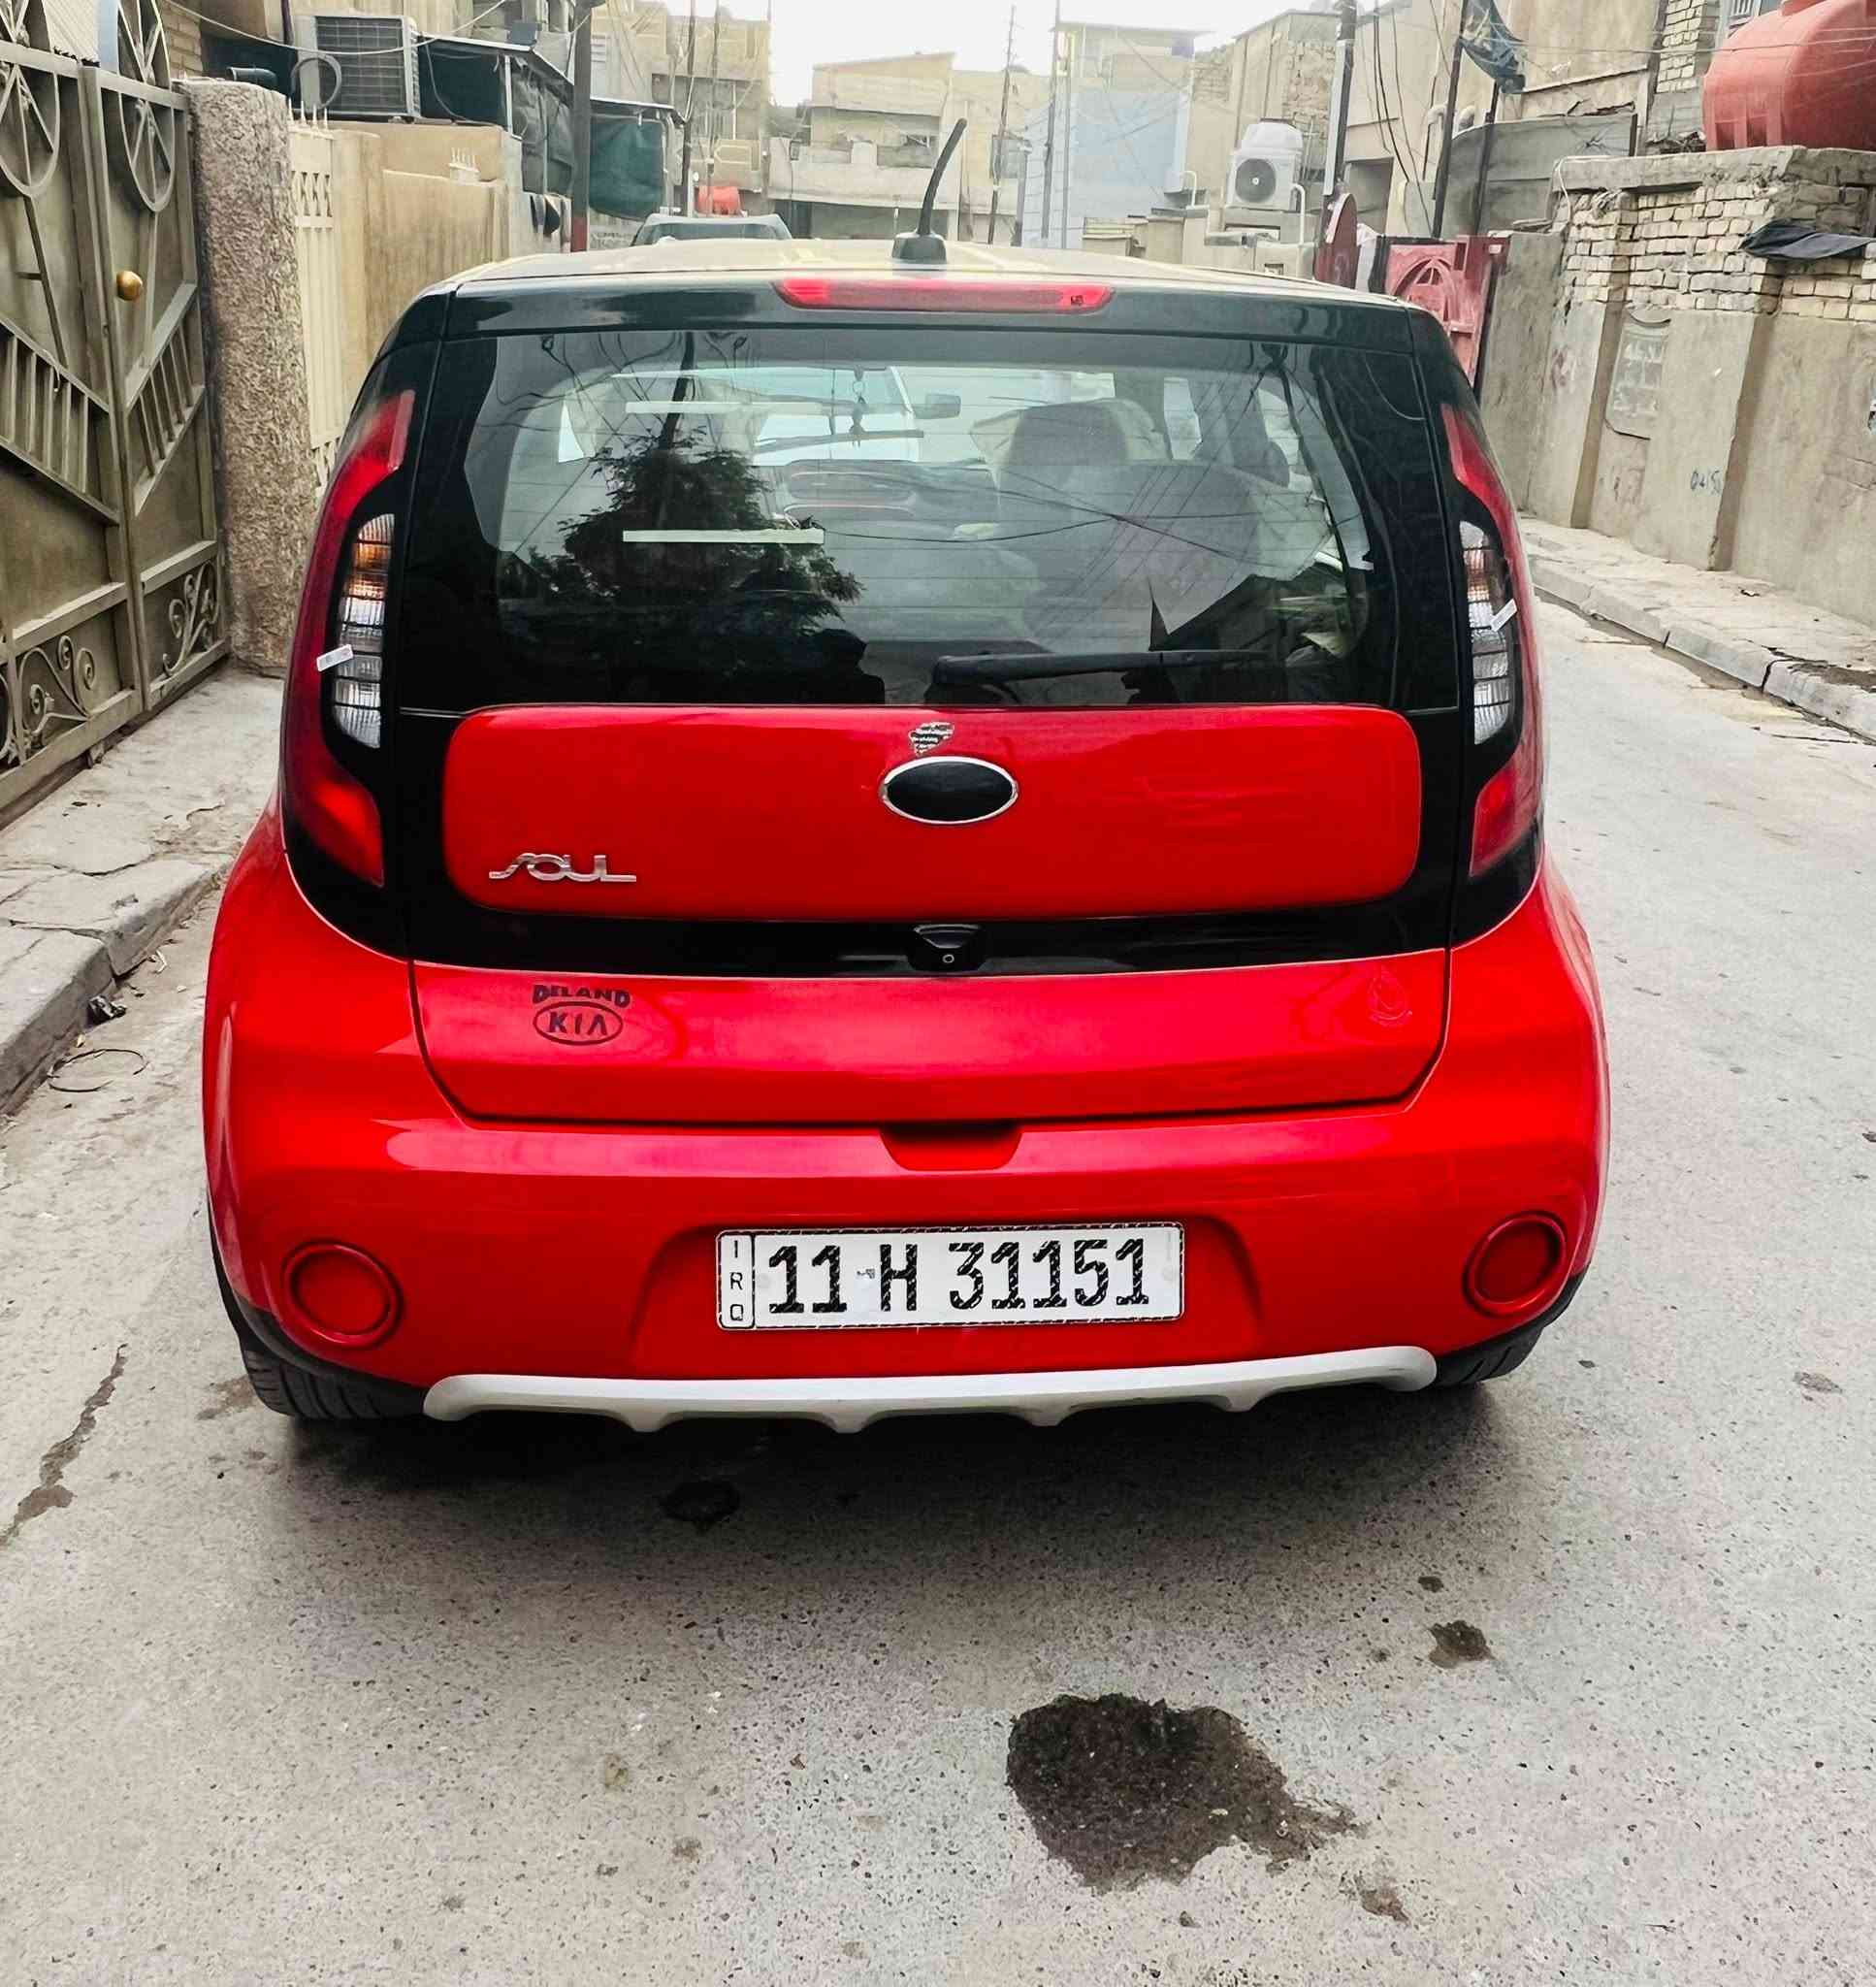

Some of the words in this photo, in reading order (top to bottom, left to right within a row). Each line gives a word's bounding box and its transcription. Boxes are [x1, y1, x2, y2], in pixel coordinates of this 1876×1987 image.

[488, 852, 637, 883] SOUL
[547, 1011, 608, 1036] KIA
[768, 1245, 848, 1314] 11
[879, 1243, 918, 1312] H
[948, 1238, 1149, 1310] 31151
